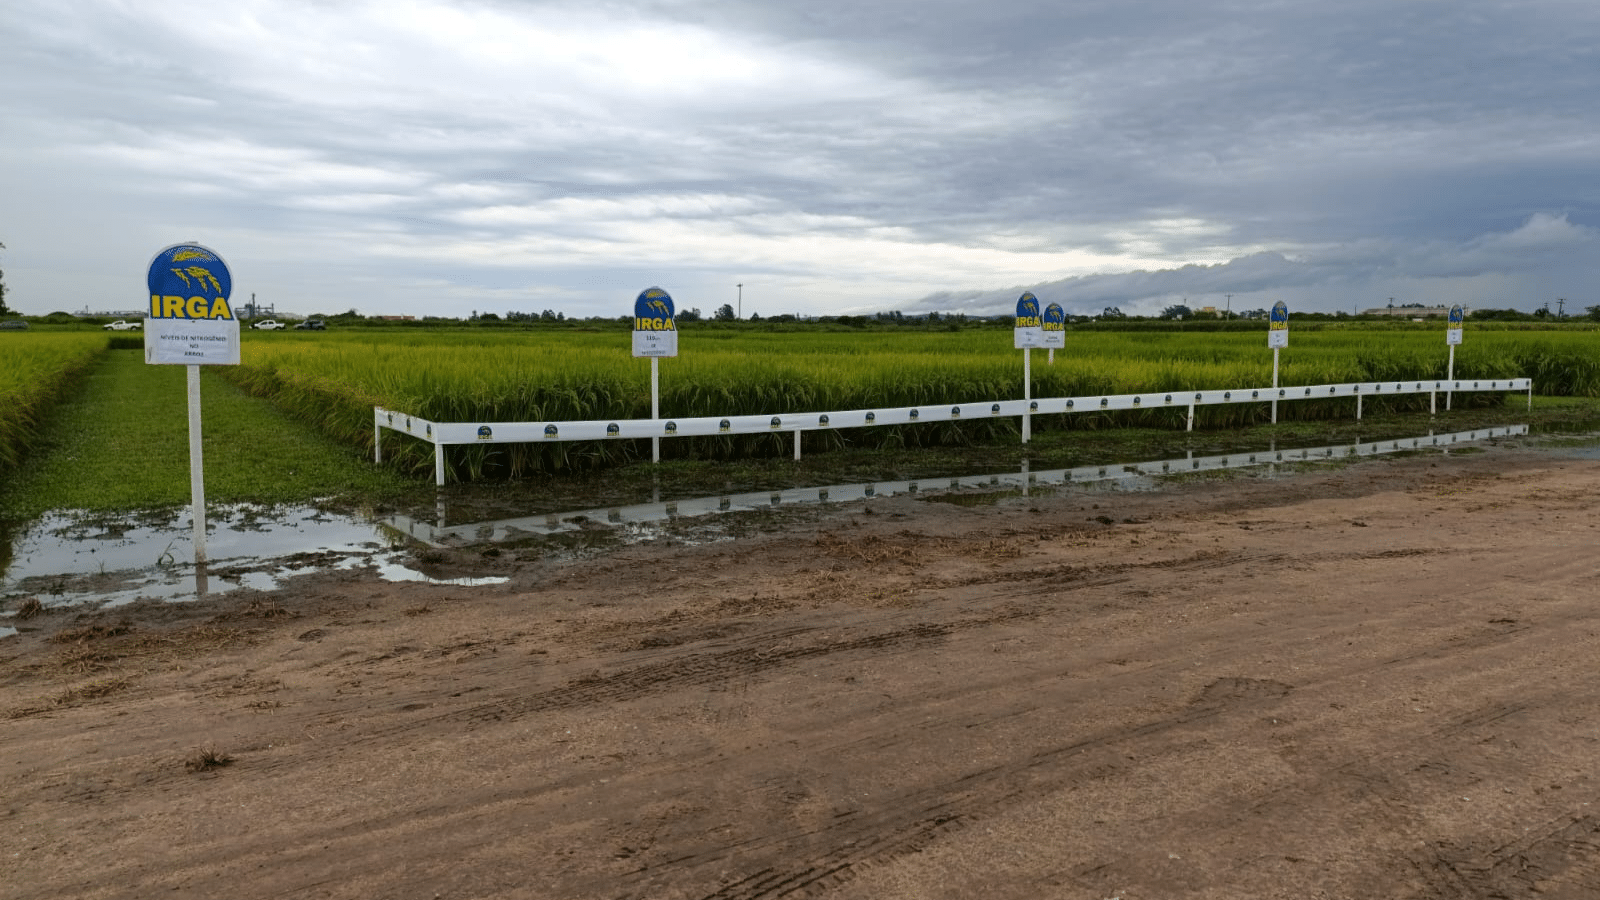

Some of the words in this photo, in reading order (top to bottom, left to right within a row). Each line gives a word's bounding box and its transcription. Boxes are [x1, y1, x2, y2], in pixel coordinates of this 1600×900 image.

[151, 295, 232, 319] IRGA
[636, 317, 673, 330] IRGA
[1015, 316, 1040, 327] IRGA
[1042, 322, 1064, 331] IRGA
